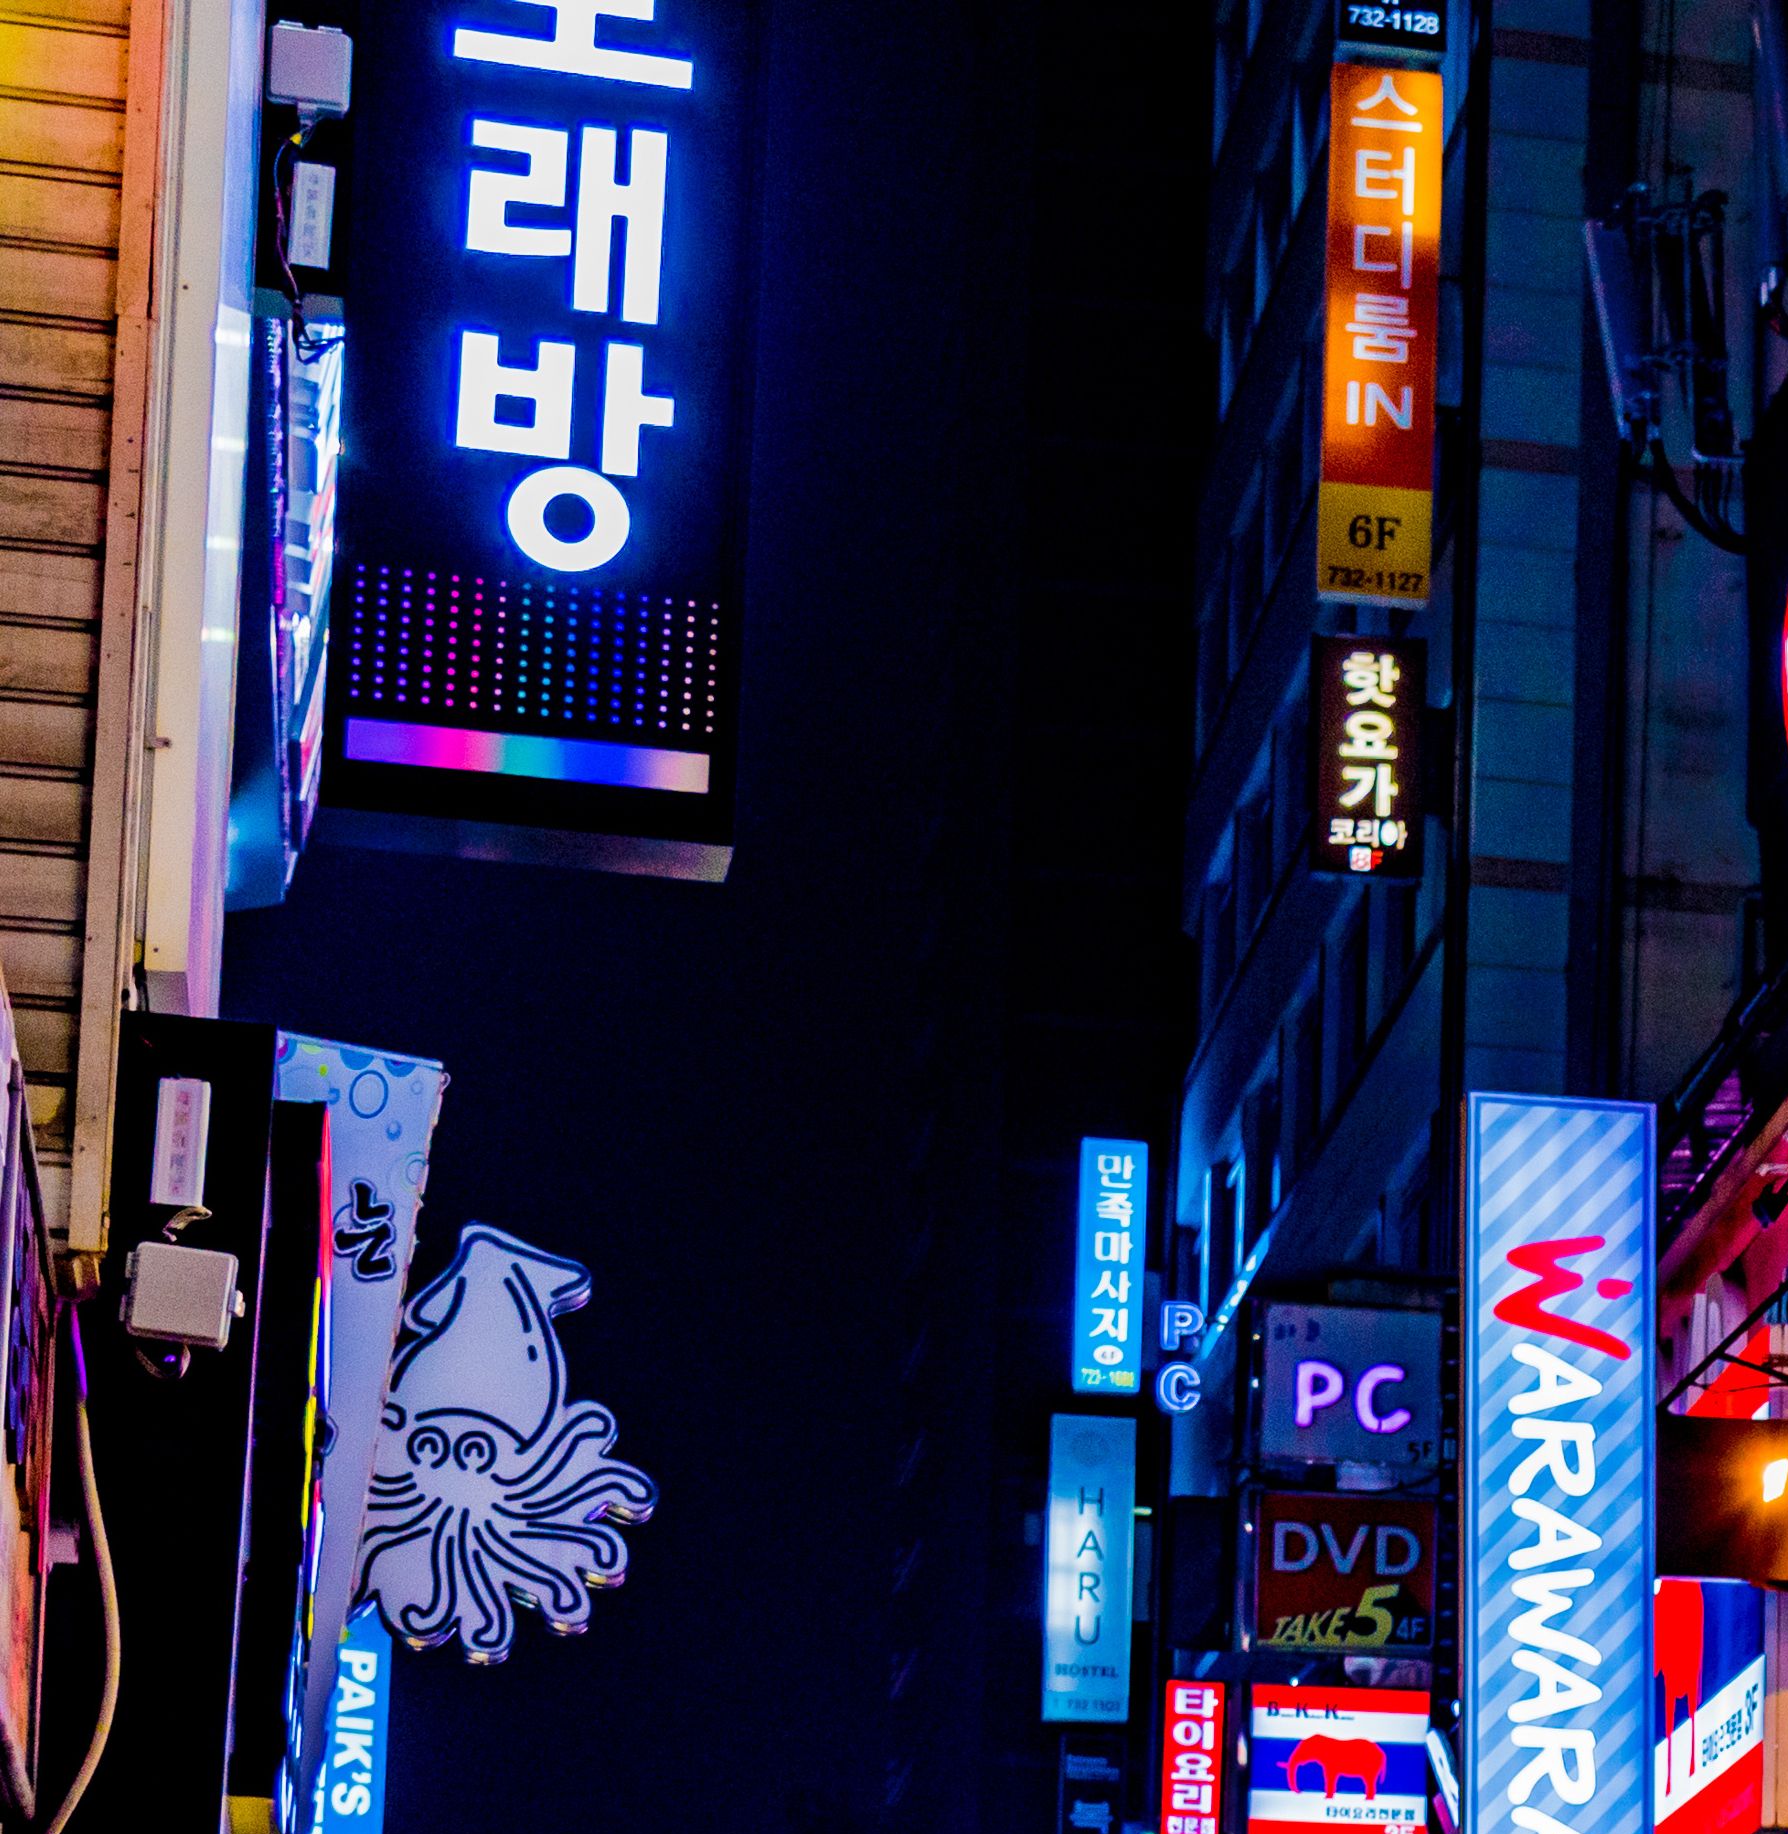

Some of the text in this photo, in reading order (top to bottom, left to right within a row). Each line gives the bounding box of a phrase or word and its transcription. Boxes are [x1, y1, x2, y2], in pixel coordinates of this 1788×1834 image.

[1348, 6, 1440, 35] 732-1128
[1345, 381, 1413, 430] IN
[1348, 514, 1402, 552] 6F
[1327, 817, 1408, 850] 코리아
[1085, 1152, 1137, 1356] 만족마사지
[1290, 1359, 1412, 1435] PC
[1075, 1488, 1105, 1646] HARU
[1271, 1522, 1422, 1577] DVD
[337, 1647, 377, 1817] PAIK'S
[1168, 1688, 1217, 1815] 타이요리
